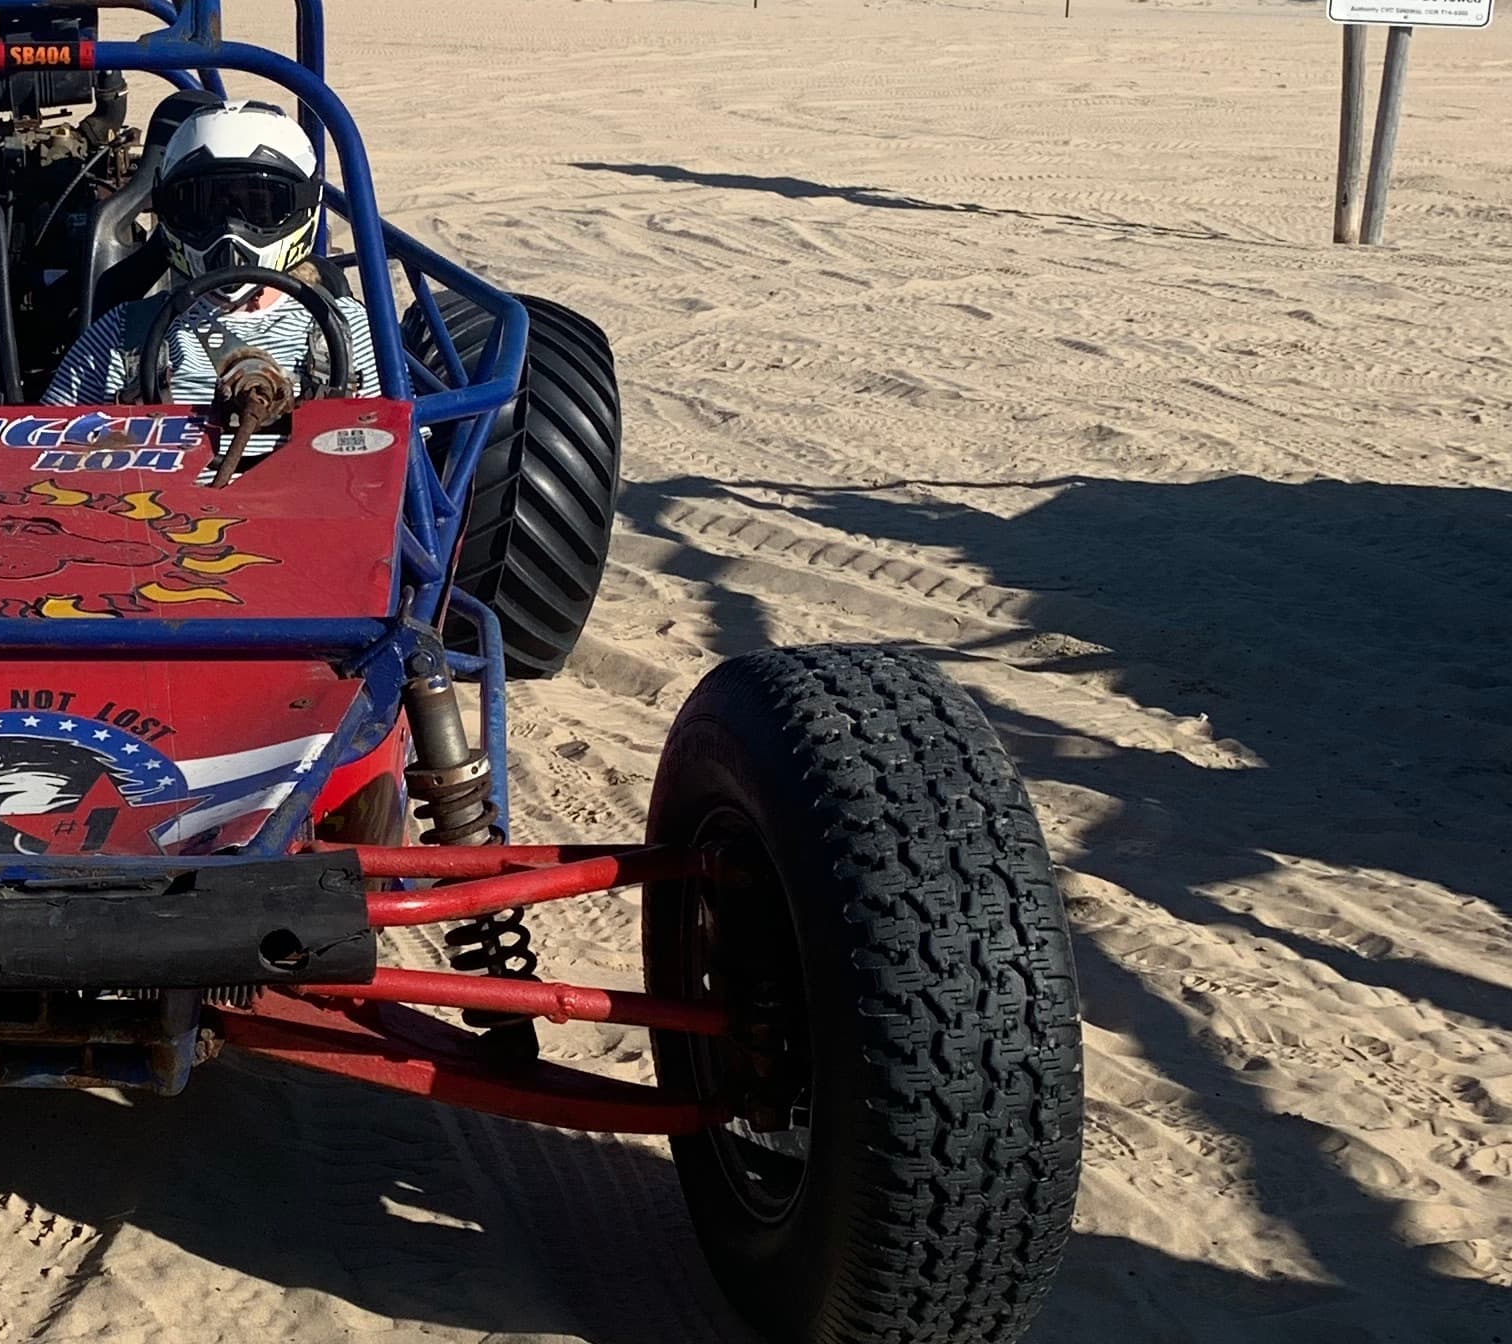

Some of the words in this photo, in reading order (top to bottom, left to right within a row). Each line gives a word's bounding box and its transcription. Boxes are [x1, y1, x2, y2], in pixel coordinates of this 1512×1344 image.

[9, 45, 71, 66] SB404
[31, 449, 185, 472] 404
[10, 689, 77, 712] NOT
[93, 702, 177, 743] LOST
